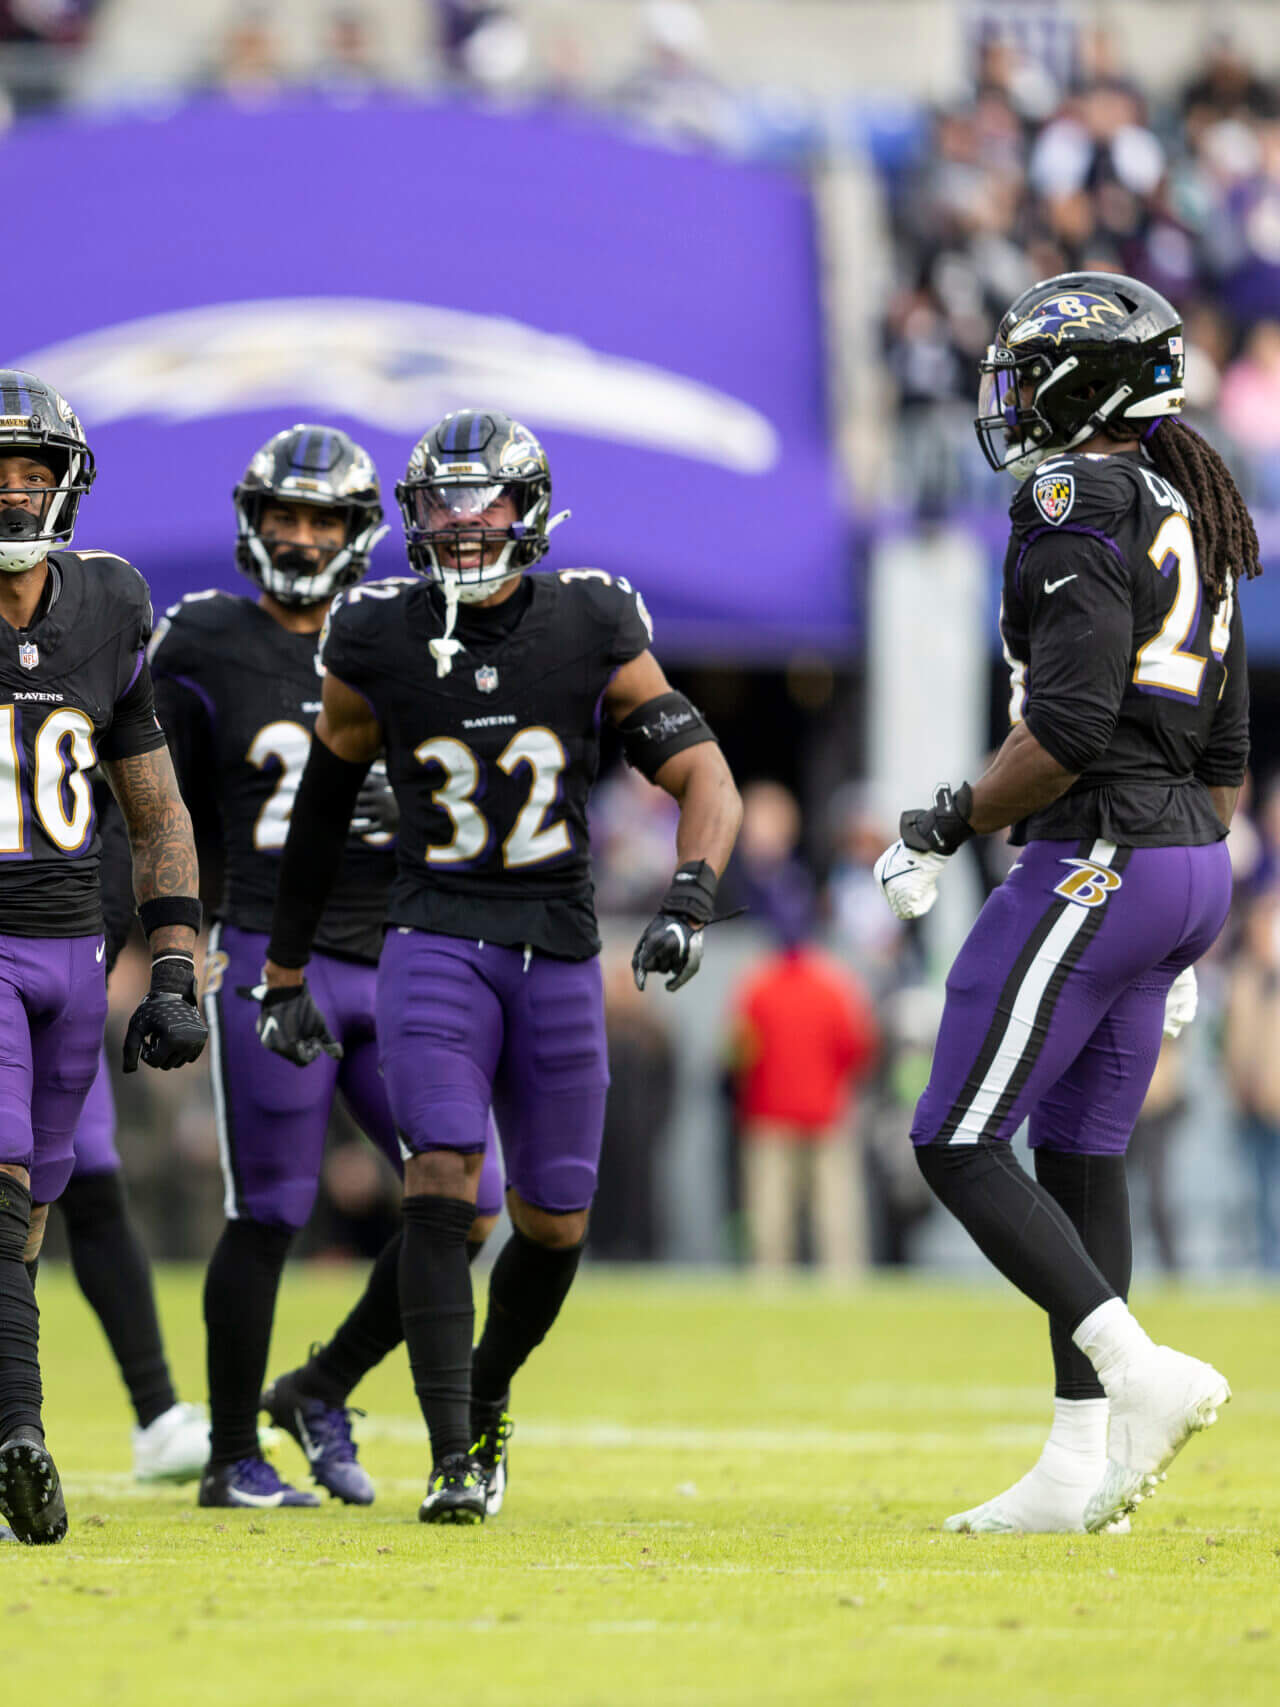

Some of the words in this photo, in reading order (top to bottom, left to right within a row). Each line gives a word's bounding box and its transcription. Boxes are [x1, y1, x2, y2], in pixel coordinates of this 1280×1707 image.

[0, 418, 30, 427] RAVENS
[12, 691, 65, 702] RAVENS
[461, 714, 518, 729] RAVENS
[413, 725, 573, 870] 32
[1052, 858, 1123, 908] B
